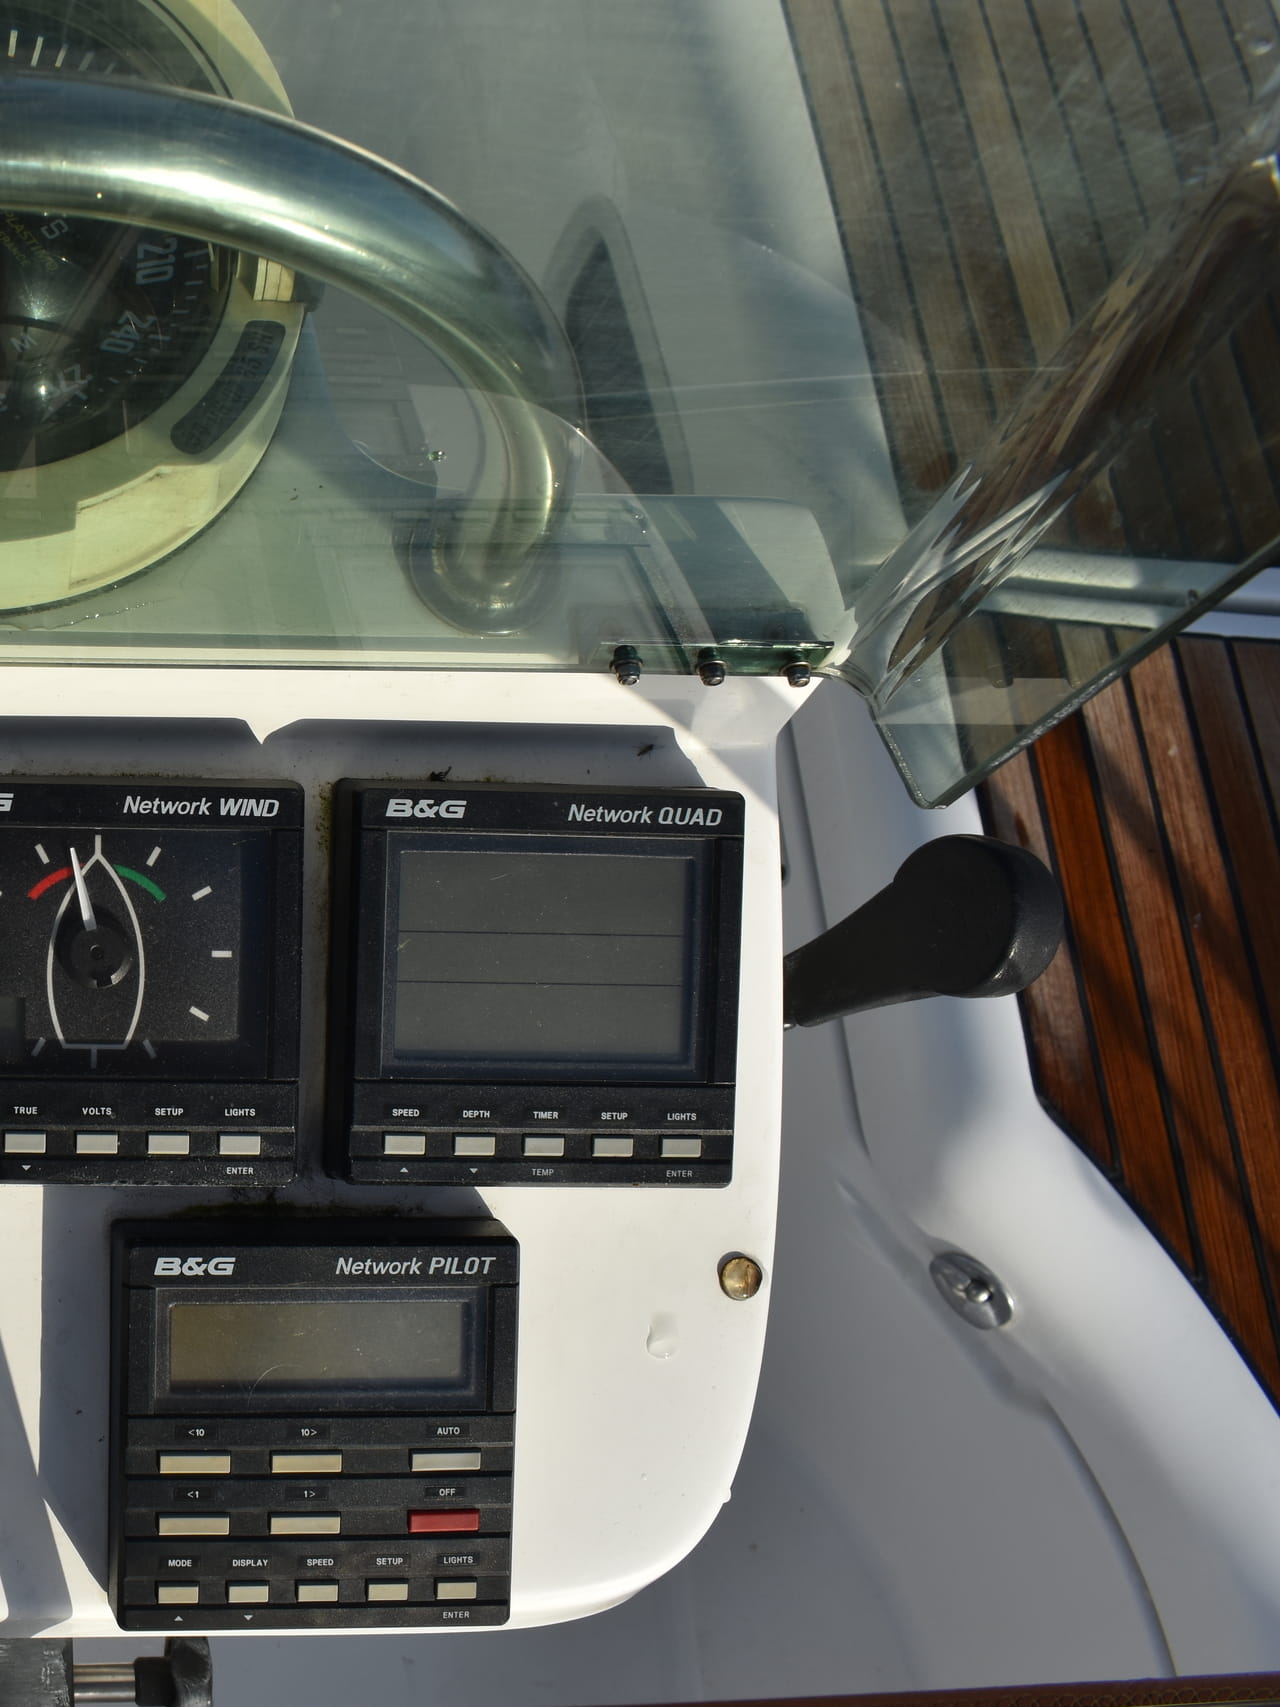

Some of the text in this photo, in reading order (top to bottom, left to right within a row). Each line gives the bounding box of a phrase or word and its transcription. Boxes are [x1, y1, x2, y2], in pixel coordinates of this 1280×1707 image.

[136, 237, 177, 286] 210
[101, 311, 157, 355] 240
[123, 795, 280, 817] Network WIND
[385, 798, 467, 819] B&G
[567, 803, 722, 826] Network QUAD
[13, 1106, 38, 1115] TRUE
[82, 1106, 112, 1116] VOLTS
[154, 1107, 184, 1117] SETUP
[224, 1108, 256, 1117] LIGHTS
[392, 1108, 420, 1117] SPEED
[462, 1109, 490, 1119] DEPTH
[533, 1110, 559, 1120] TIMER
[601, 1111, 628, 1121] SETUP
[667, 1112, 697, 1121] LIGHTS
[226, 1166, 254, 1175] ENTER
[531, 1168, 554, 1177] TEMP
[666, 1169, 693, 1178] ENTER
[153, 1256, 236, 1276] B&G
[335, 1256, 496, 1276] Network PILOT
[436, 1426, 460, 1435] AUTO
[438, 1488, 455, 1497] OFF
[168, 1559, 192, 1567] MODE
[232, 1558, 268, 1567] DISPLAY
[306, 1558, 334, 1567] SPEED
[376, 1557, 403, 1566] SETUP
[443, 1555, 473, 1564] LIGHTS
[442, 1610, 470, 1619] ENTER
